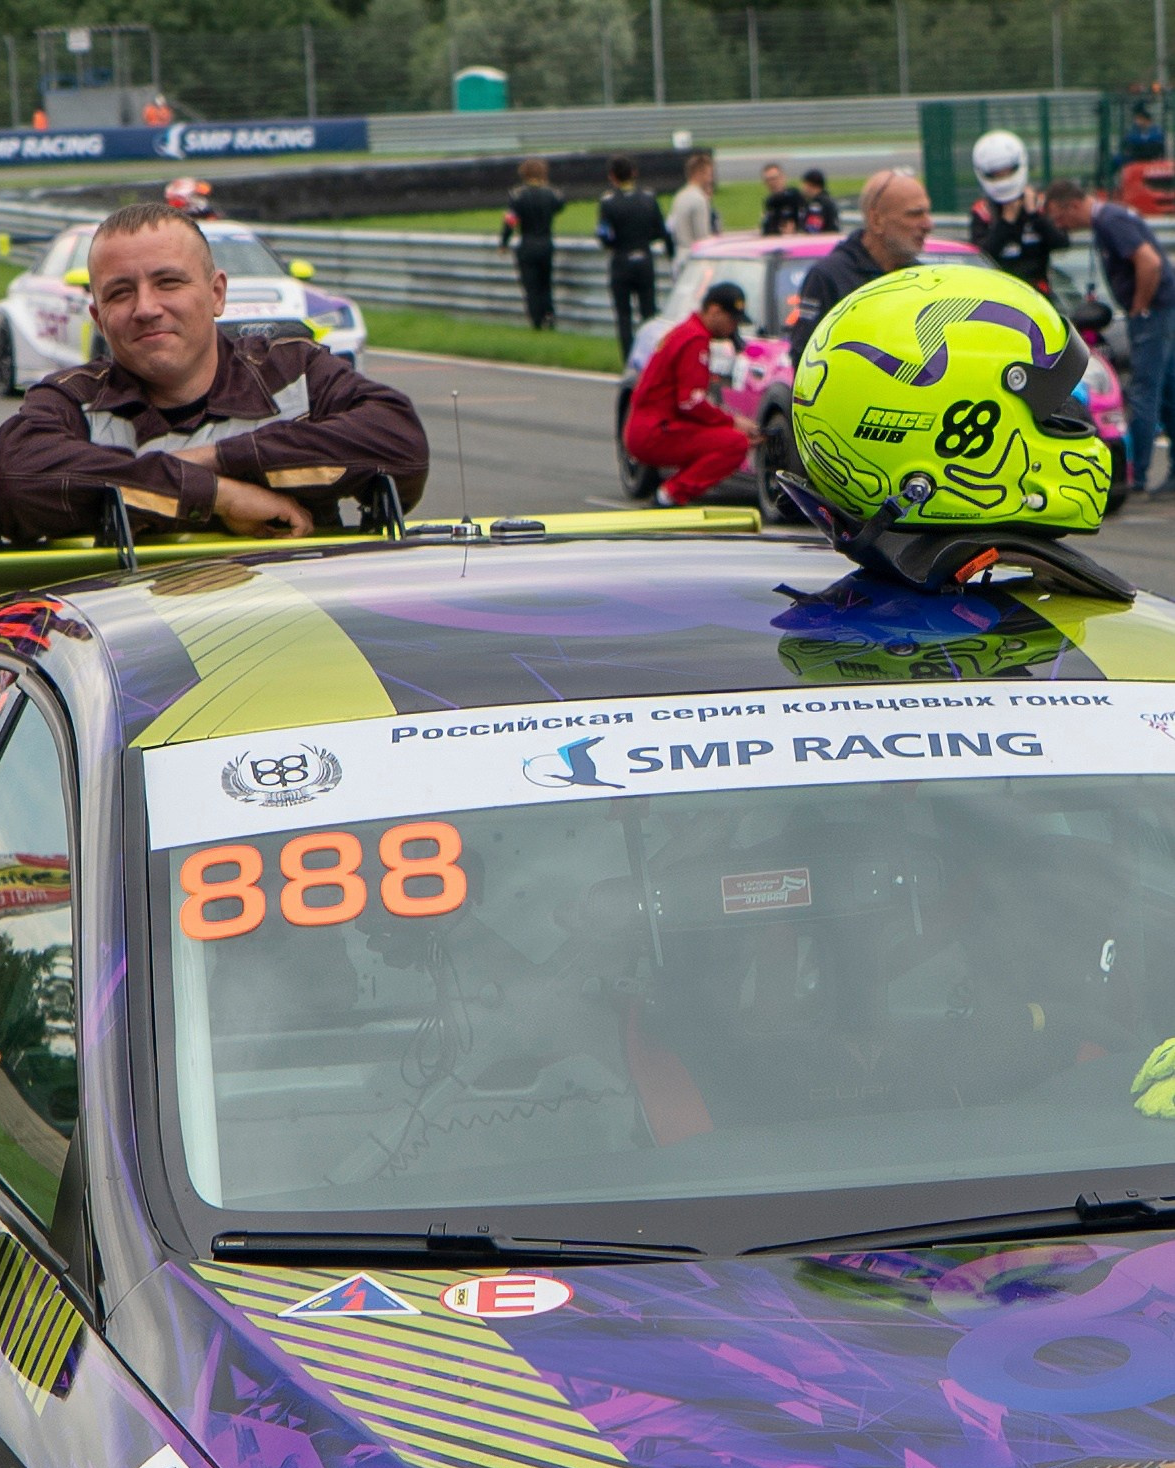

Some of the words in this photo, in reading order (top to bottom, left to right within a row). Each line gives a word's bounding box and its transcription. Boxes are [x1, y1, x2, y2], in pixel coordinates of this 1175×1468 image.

[24, 134, 103, 157] RACING
[184, 132, 233, 152] SMP
[234, 127, 315, 150] RACING
[863, 408, 935, 431] RACE
[853, 425, 907, 444] HUB
[391, 709, 634, 744] Российская
[650, 703, 766, 723] серия
[782, 694, 996, 714] кольцевых
[1009, 692, 1114, 707] гонок
[627, 738, 774, 775] SMP
[792, 731, 1045, 764] RACING
[179, 821, 468, 941] 888
[476, 1279, 536, 1313] E
